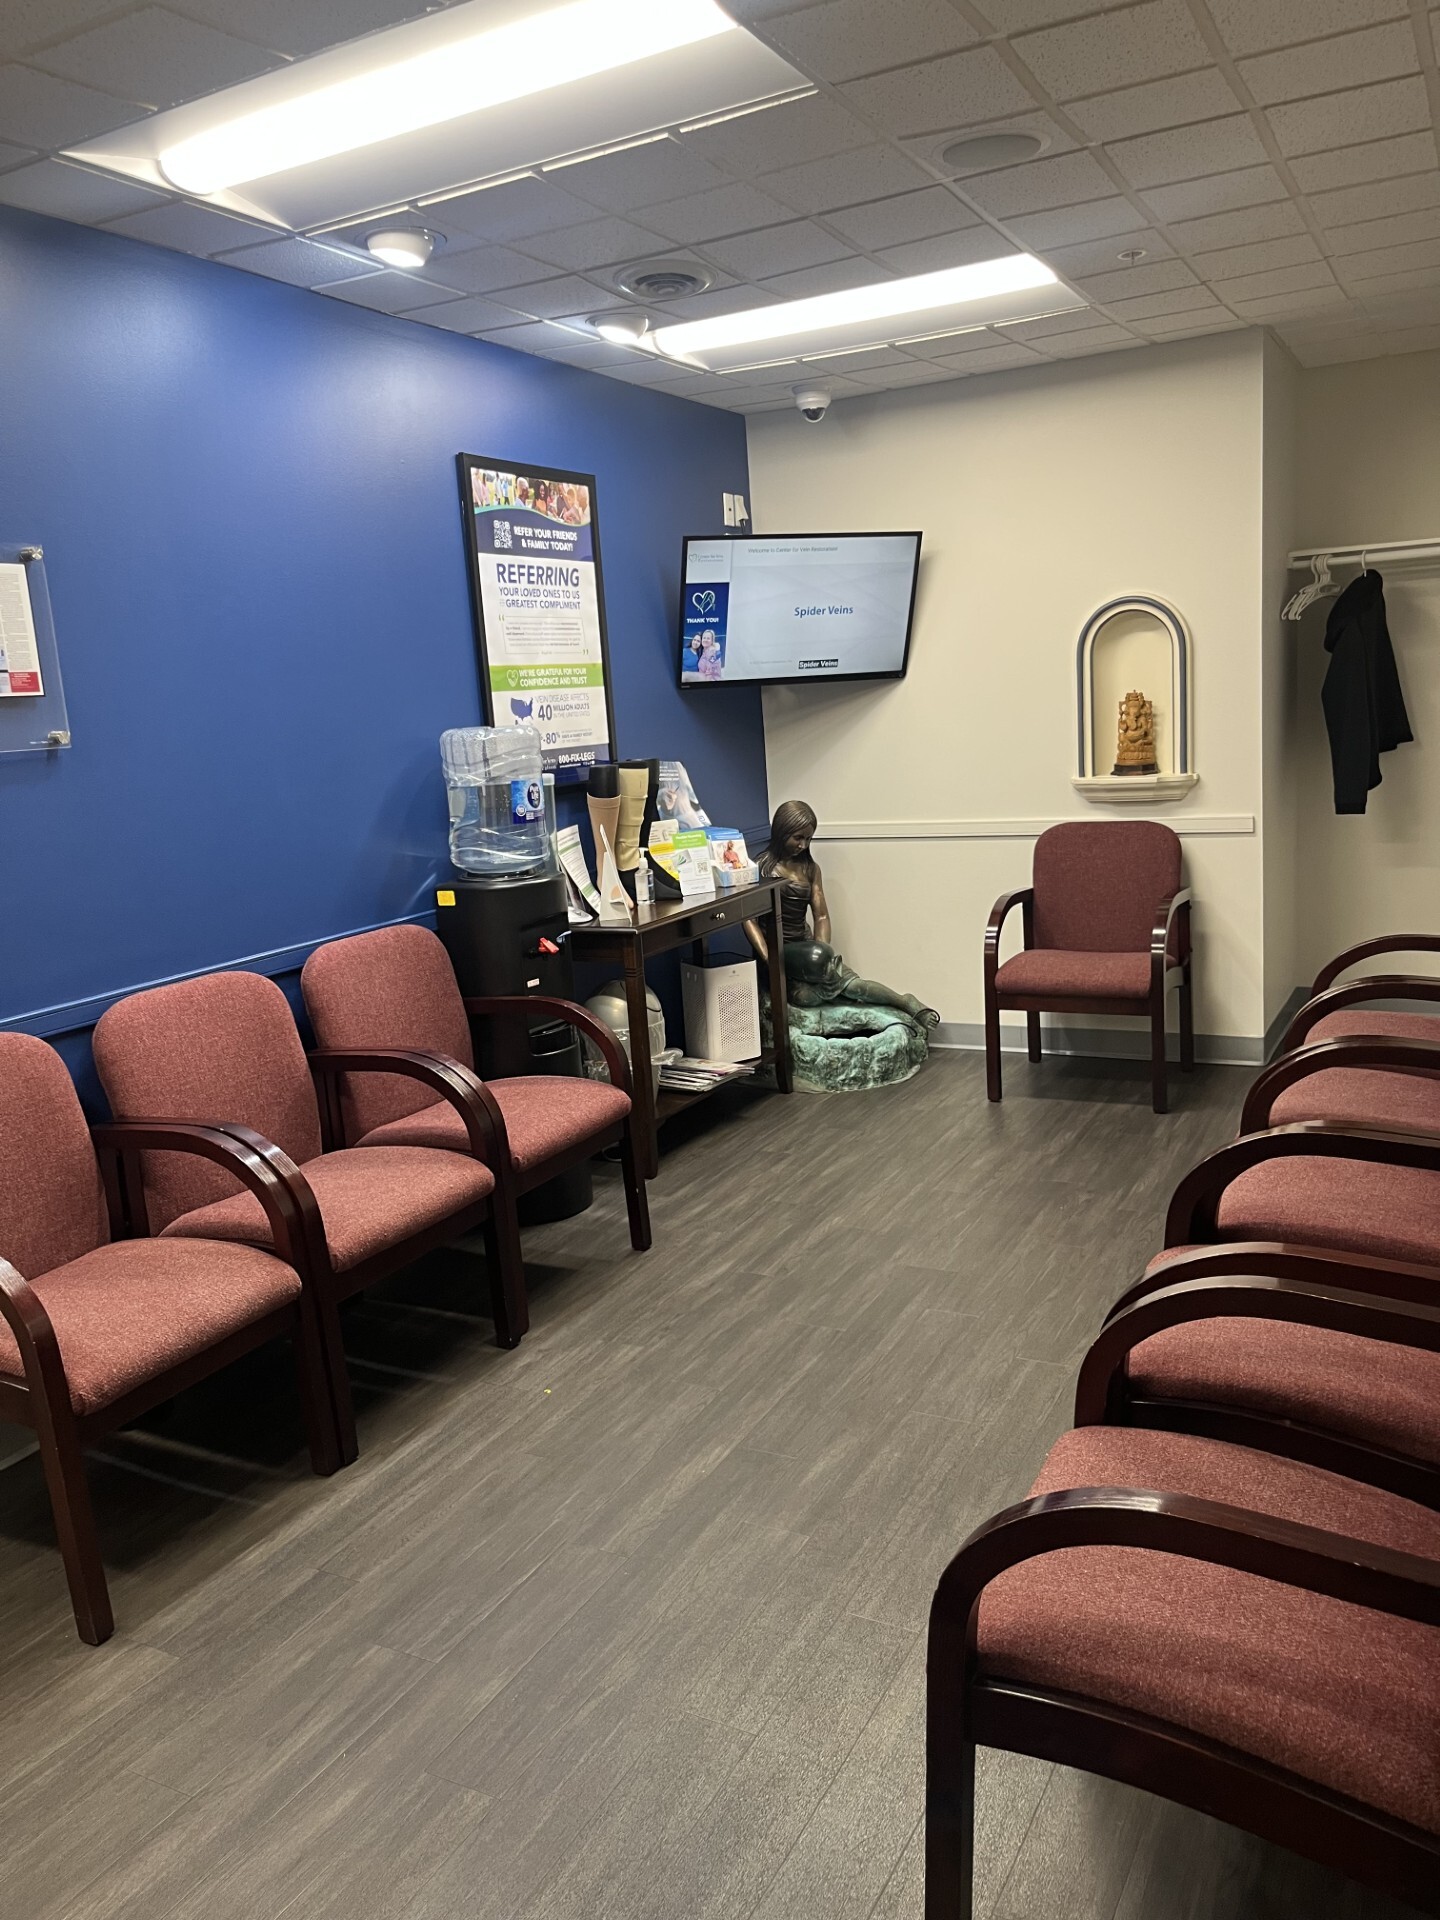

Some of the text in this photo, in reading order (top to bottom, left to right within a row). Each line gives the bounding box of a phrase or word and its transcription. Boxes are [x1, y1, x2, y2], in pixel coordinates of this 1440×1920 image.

[513, 526, 578, 541] REFER YOUR FRIENDS
[521, 539, 573, 552] & FAMILY TODAY!
[496, 563, 580, 587] REFERRING
[499, 587, 580, 600] YOUR LOVED ONES TO US
[505, 599, 538, 609] GREATEST
[539, 600, 581, 610] COMPLIMENT
[794, 605, 854, 618] Spider Veins
[799, 661, 819, 669] Spider
[820, 659, 838, 668] Veins
[518, 669, 535, 677] WE'RE
[536, 668, 563, 677] GRATEFUL
[573, 667, 587, 675] YOUR
[520, 676, 587, 687] CONFIDENCE AND TRUST
[535, 695, 549, 704] VEIN
[549, 694, 569, 703] DISEASE
[538, 704, 553, 721] 40
[574, 702, 590, 710] ADULTS
[558, 751, 595, 764] 800-FIX-LEGS
